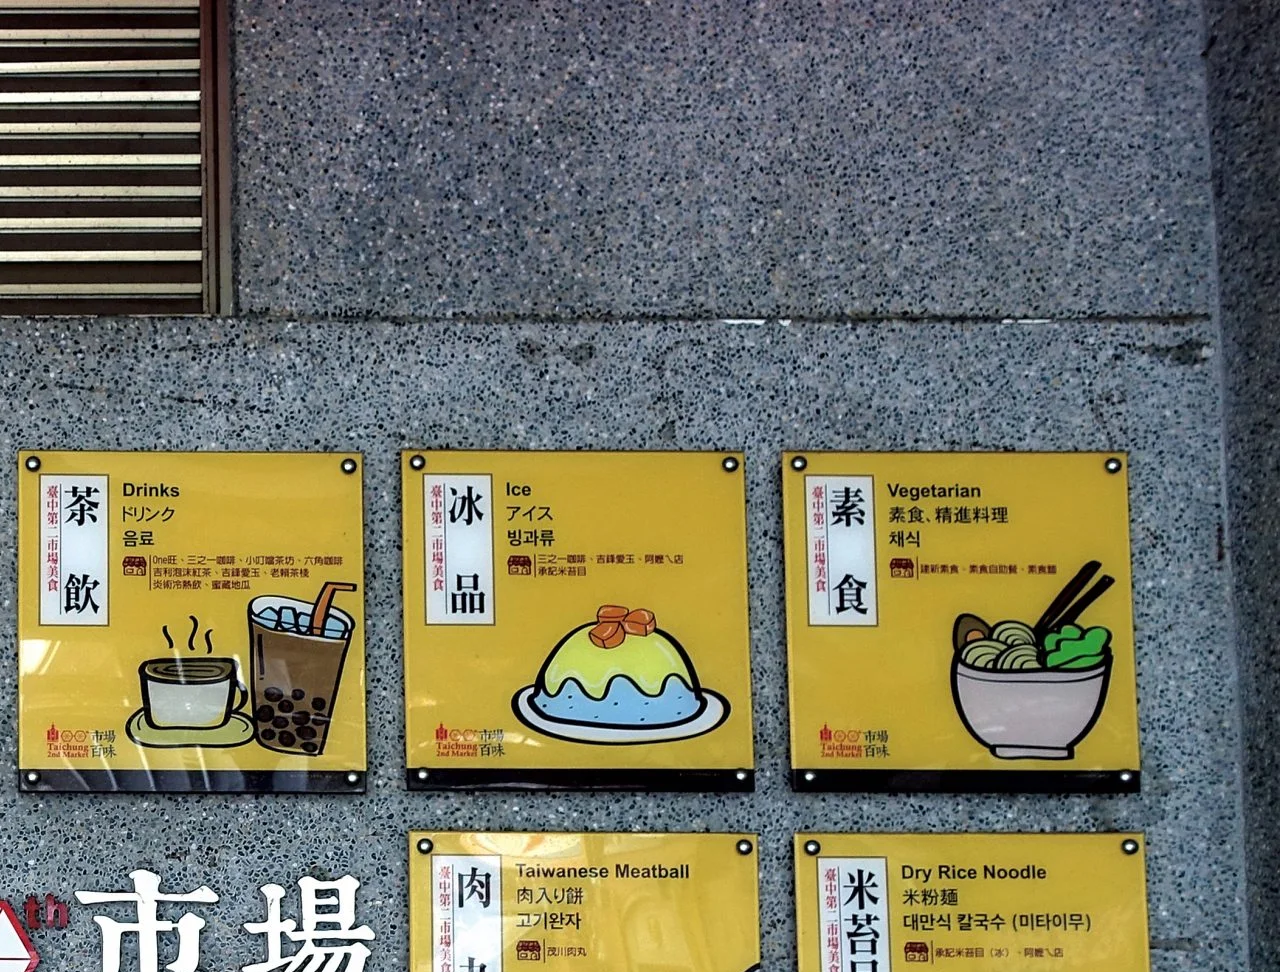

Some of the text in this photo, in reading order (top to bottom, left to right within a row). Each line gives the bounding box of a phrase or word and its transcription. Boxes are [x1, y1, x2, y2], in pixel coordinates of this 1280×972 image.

[123, 483, 180, 497] Drinks
[506, 483, 531, 496] Ice
[888, 484, 981, 500] Vegetarian
[123, 507, 175, 522] ドリンク
[506, 506, 553, 521] アイス
[888, 507, 1008, 524] 素食、精進料理
[123, 531, 154, 547] 음료
[507, 530, 555, 547] 빙과류
[889, 531, 920, 547] 채식
[64, 486, 100, 615] 茶飲
[449, 485, 485, 614] 冰品
[830, 487, 868, 615] 素食
[516, 863, 689, 879] Taiwanese Meatball
[902, 865, 1046, 882] Dry Rice Noodle
[517, 887, 583, 905] 肉入り餅
[516, 913, 581, 930] 고기완자
[903, 913, 1091, 931] 대만식 칼국수 (미타이무)
